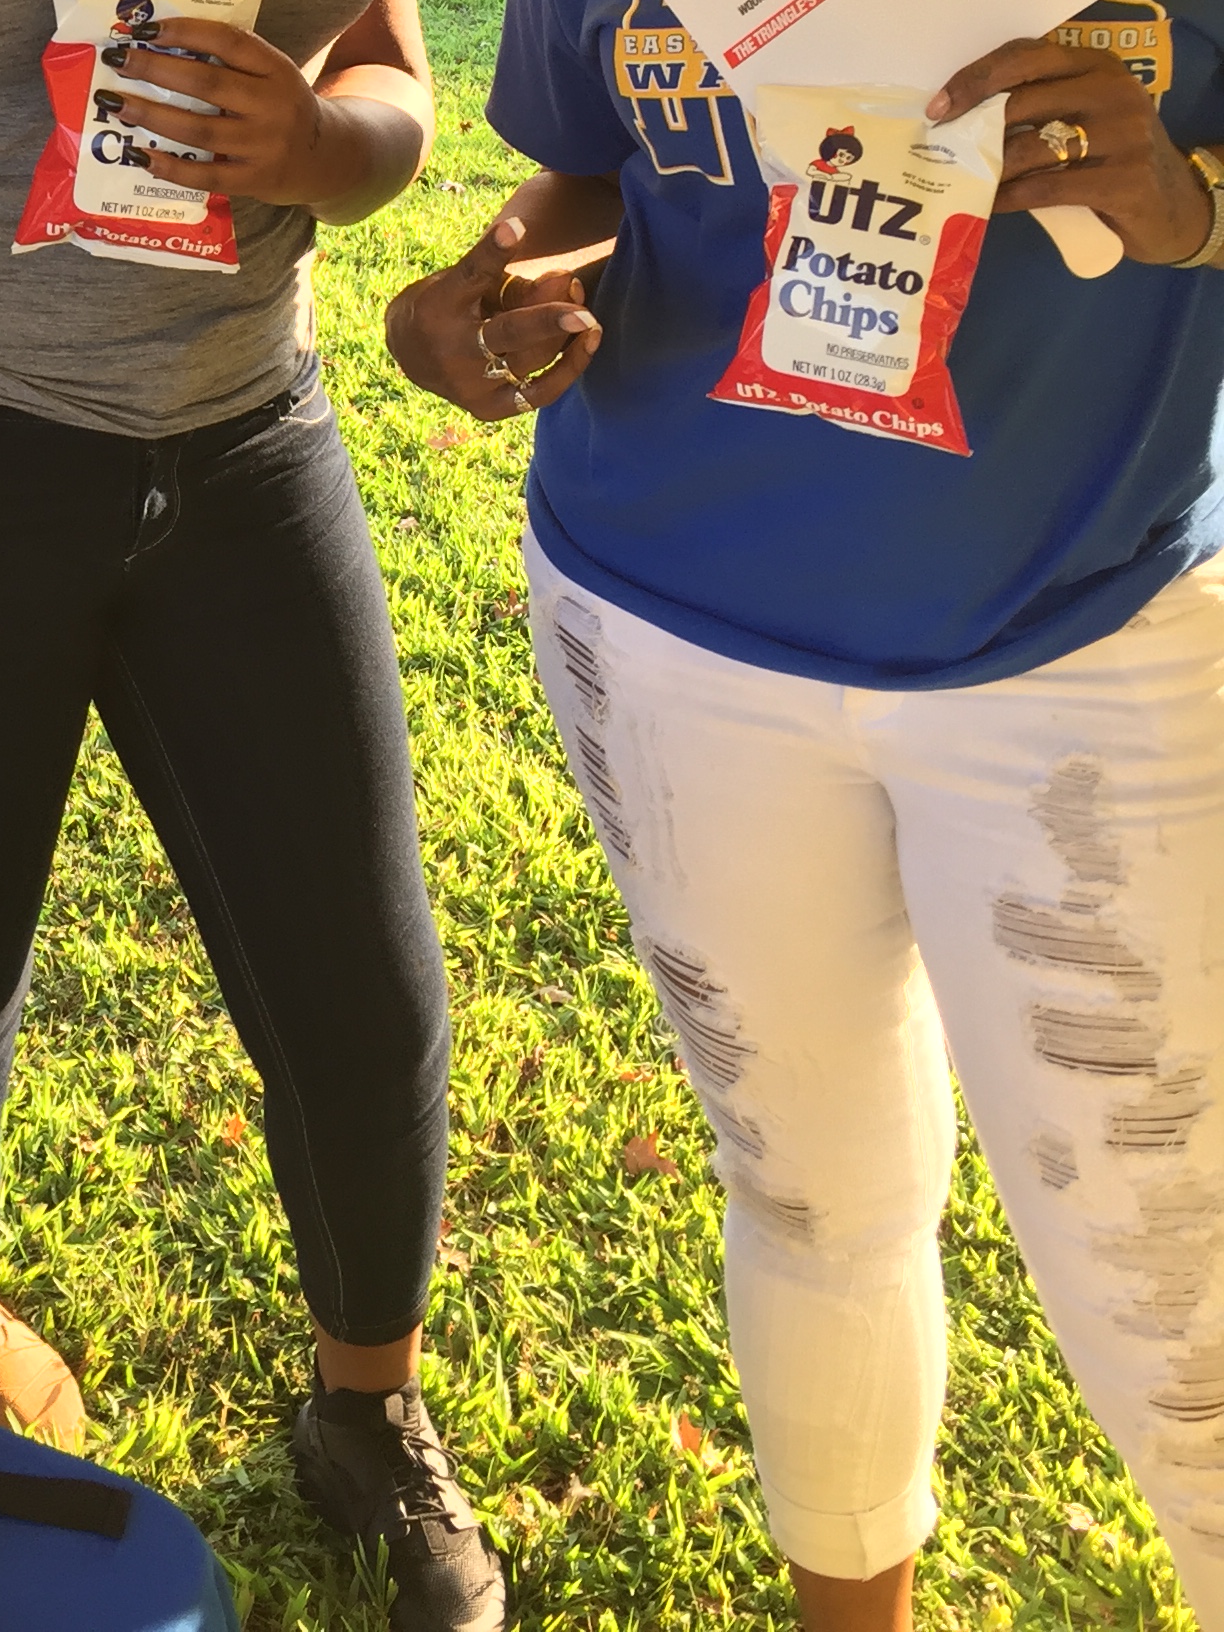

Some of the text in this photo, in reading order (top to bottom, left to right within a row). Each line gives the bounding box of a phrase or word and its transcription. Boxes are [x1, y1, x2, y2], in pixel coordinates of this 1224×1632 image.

[732, 36, 758, 62] THE
[1056, 27, 1158, 49] HOOL
[133, 184, 206, 202] NO PRESERVATIVES
[101, 201, 119, 213] NET
[120, 203, 134, 215] WT
[141, 206, 155, 217] OZ
[94, 225, 162, 247] Potato
[165, 236, 223, 256] Chips
[782, 235, 925, 295] Potato
[778, 279, 899, 340] Chips
[826, 343, 910, 370] NO PRESERVATIVES
[792, 359, 810, 374] NET
[813, 363, 827, 378] WT
[838, 368, 852, 383] OZ
[789, 392, 870, 424] Potato
[872, 410, 944, 438] Chips
